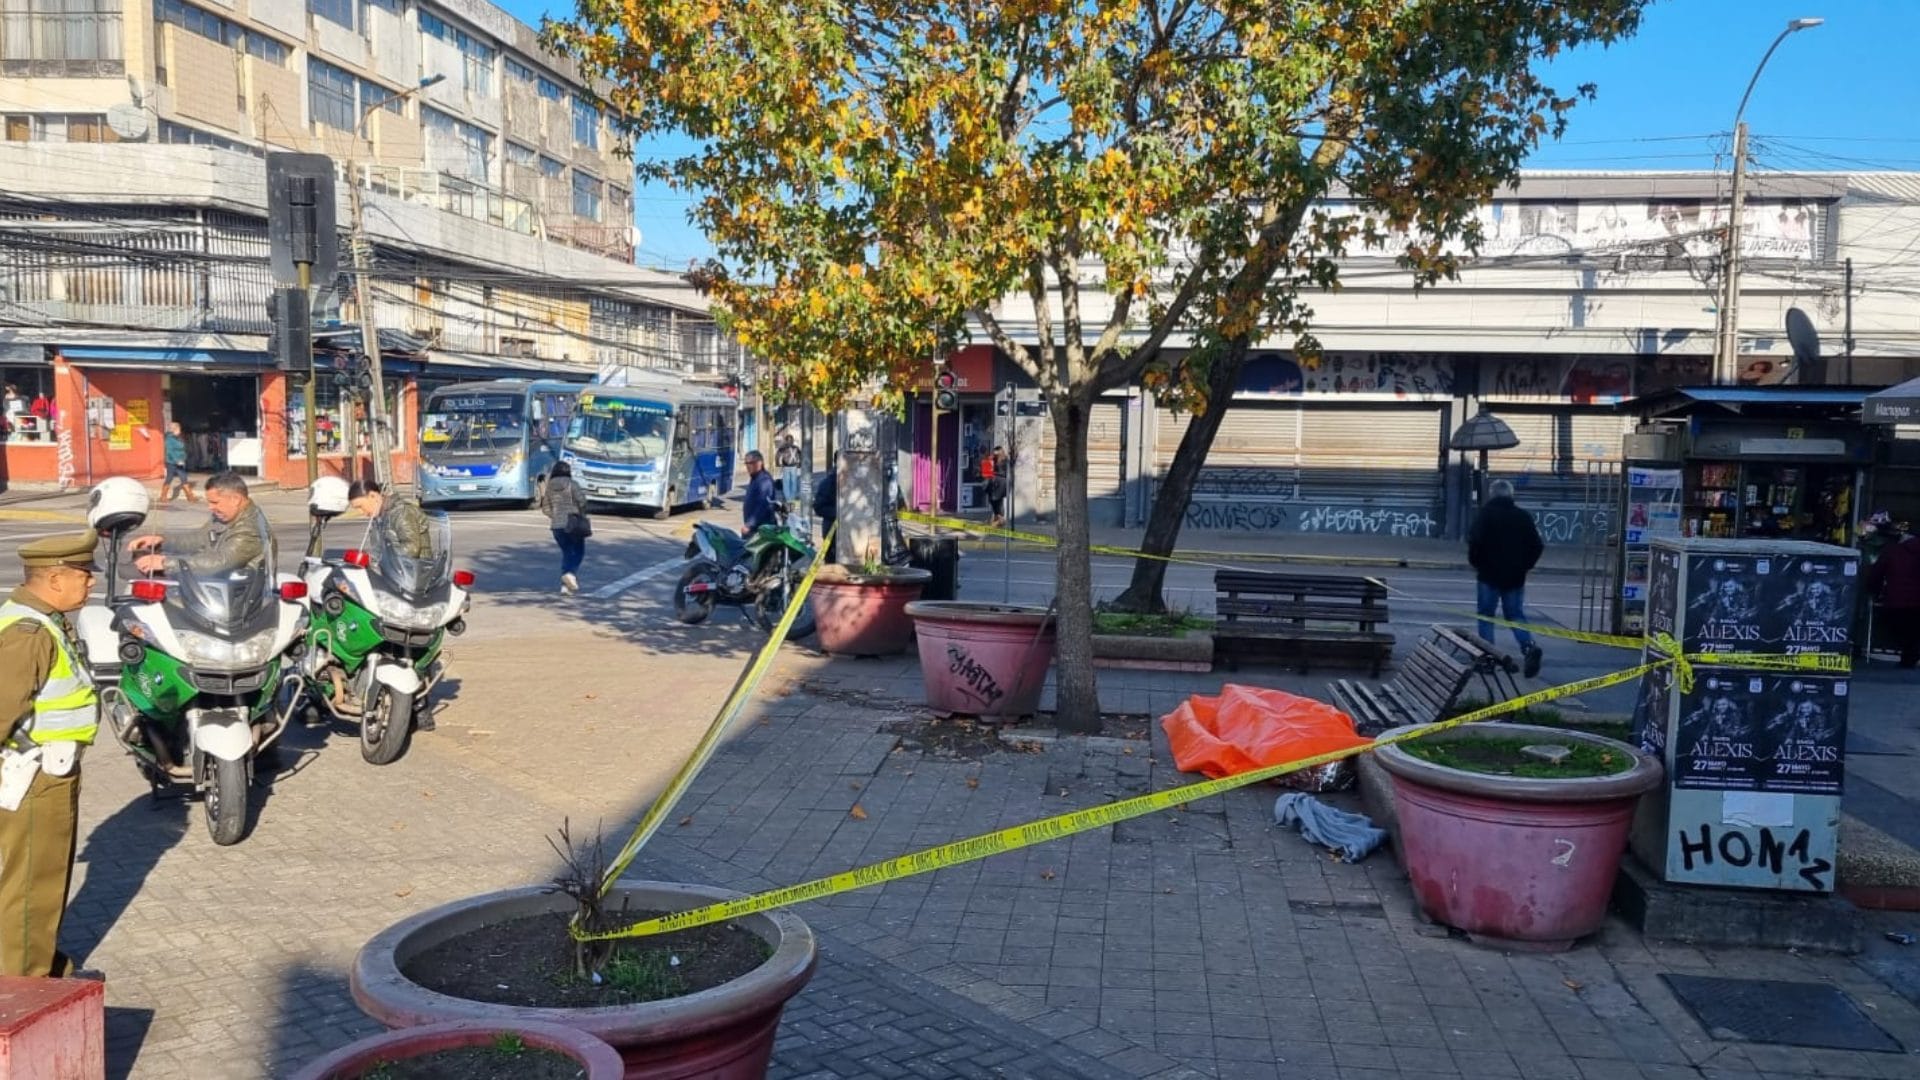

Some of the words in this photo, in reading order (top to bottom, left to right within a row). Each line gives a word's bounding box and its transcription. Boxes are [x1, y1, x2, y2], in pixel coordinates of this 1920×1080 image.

[1697, 623, 1760, 640] ALEXIS
[1782, 625, 1848, 642] ALEXIS
[1700, 643, 1715, 653] 27
[1785, 645, 1800, 655] 27
[1690, 741, 1753, 758] ALEXIS
[1773, 743, 1837, 761] ALEXIS
[1693, 759, 1707, 770] 27
[1776, 763, 1791, 774] 27
